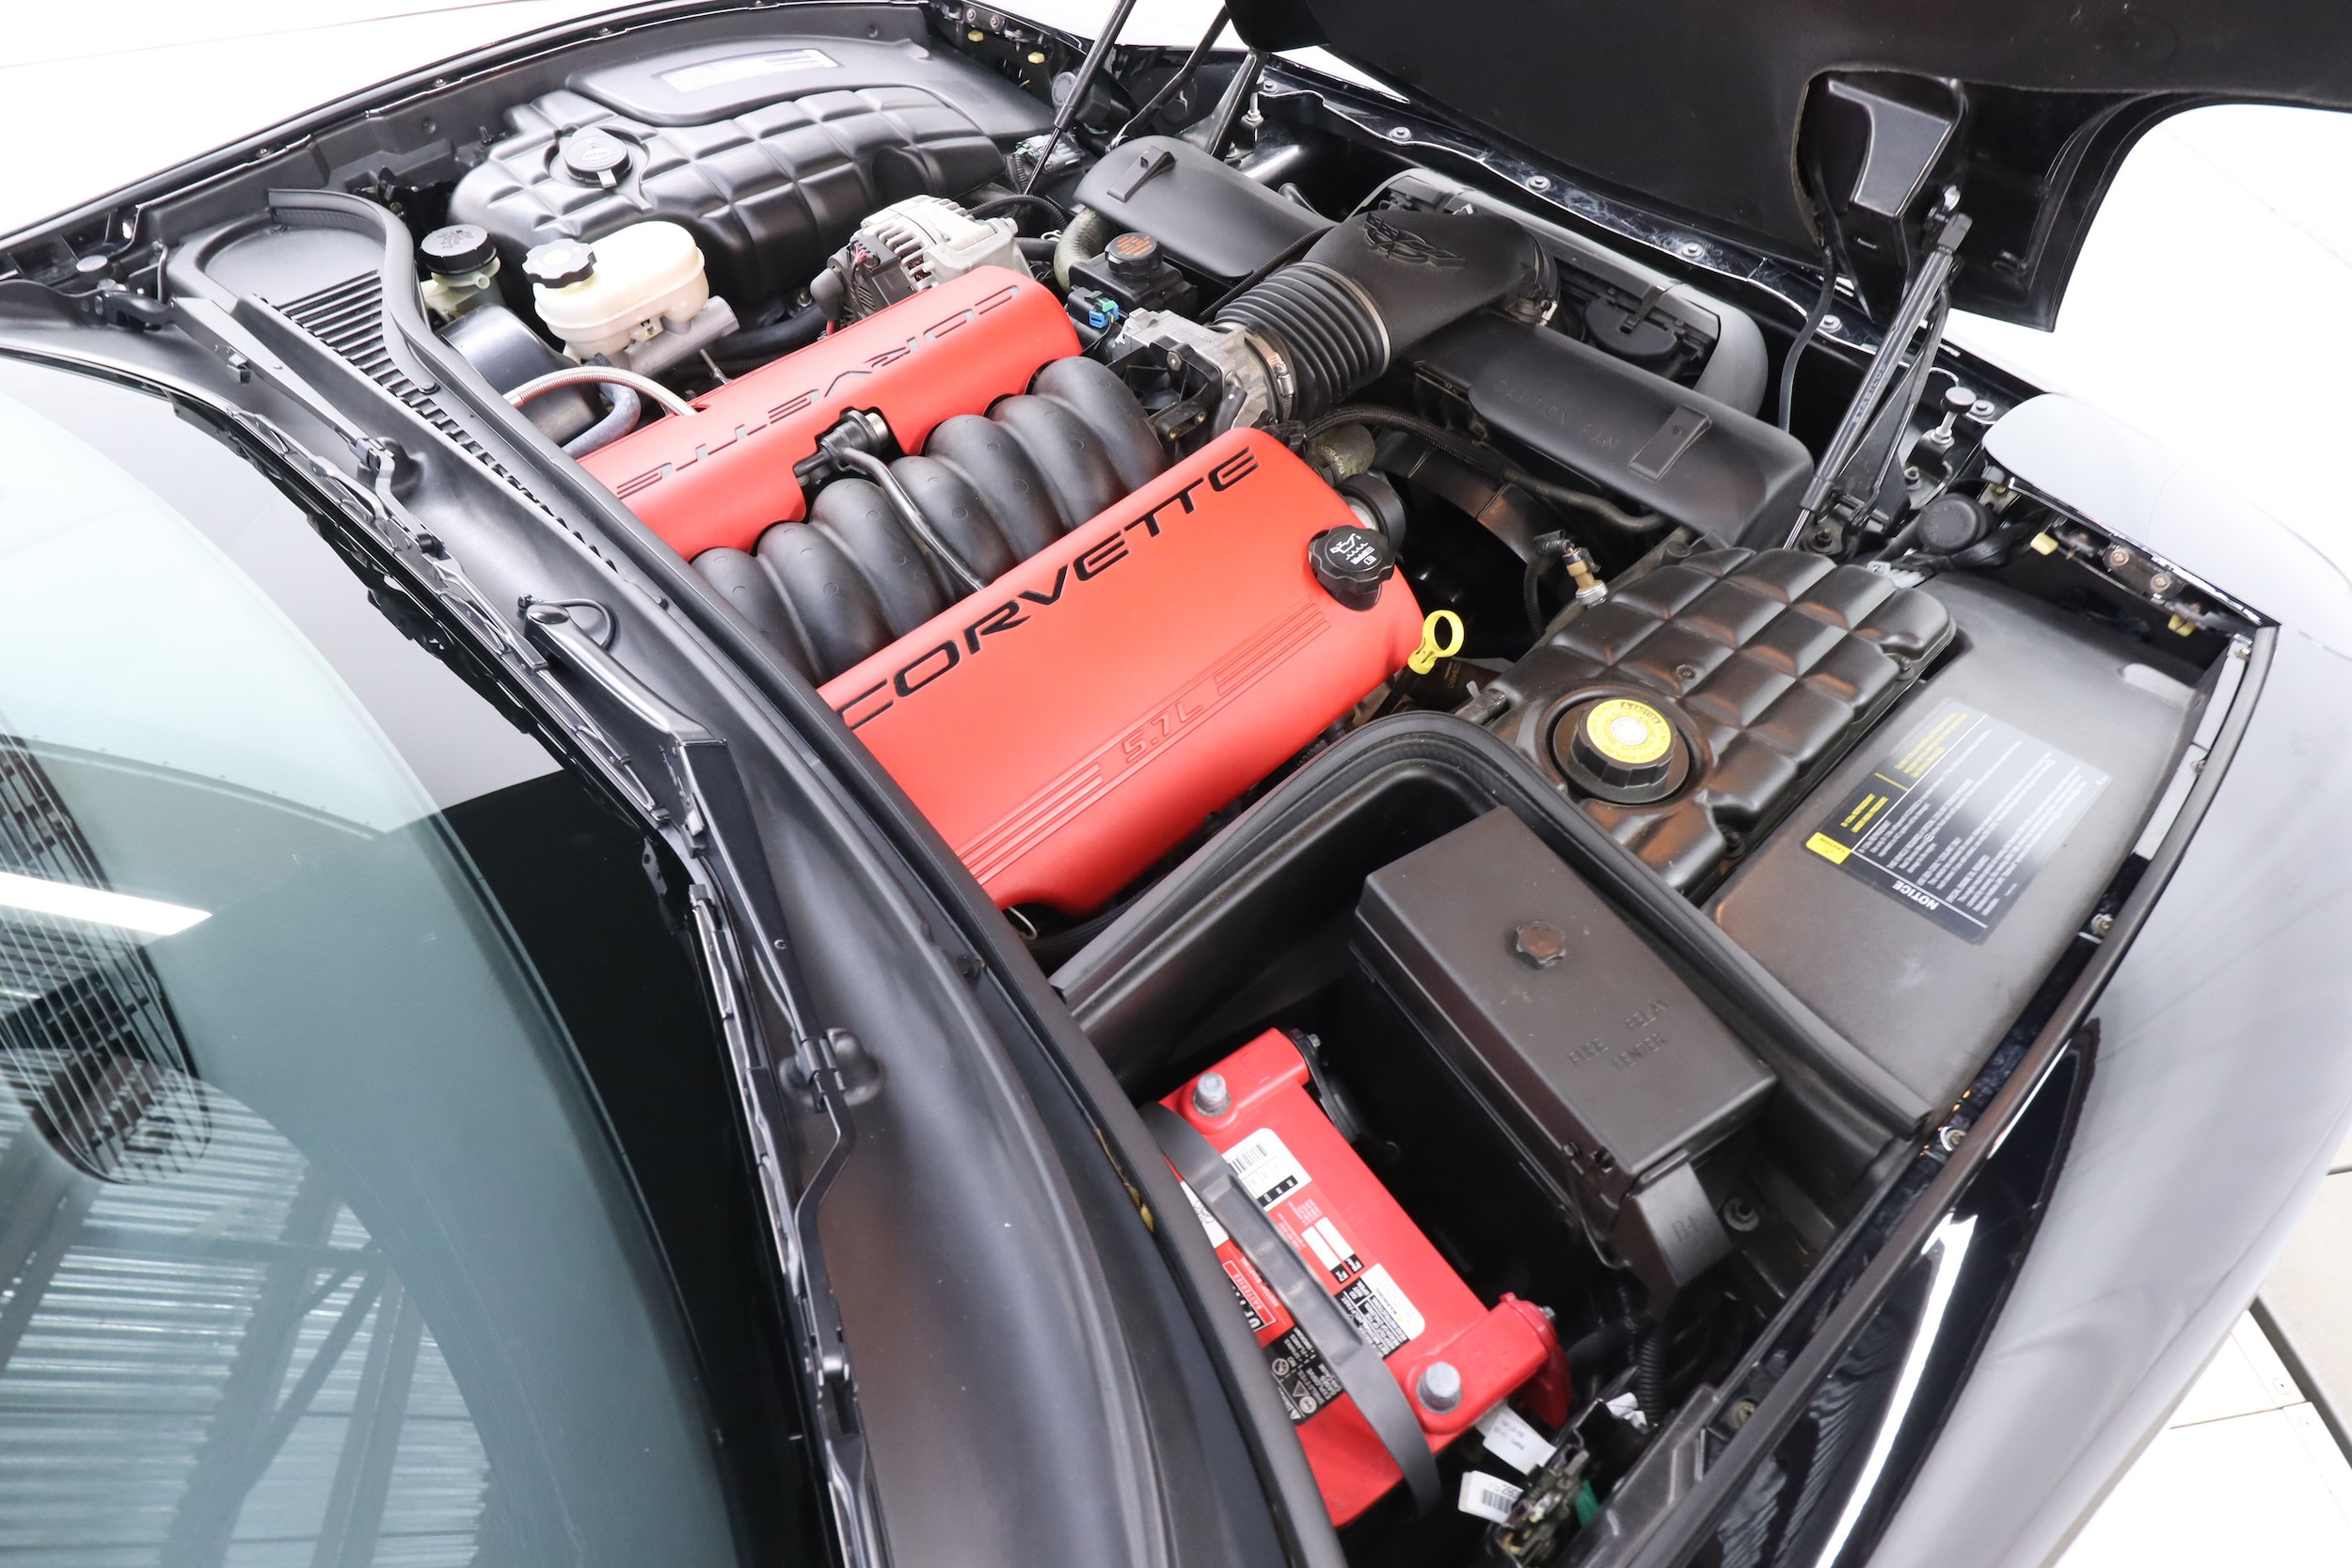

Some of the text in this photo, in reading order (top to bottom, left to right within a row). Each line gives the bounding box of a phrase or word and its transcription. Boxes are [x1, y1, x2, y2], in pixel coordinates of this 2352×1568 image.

[836, 447, 1259, 730] CORVETTE
[1631, 705, 1661, 723] CAUTION
[1123, 703, 1204, 764] 5.7L
[1892, 878, 1939, 911] NOTICE
[1671, 1215, 1697, 1242] B+
[1239, 1256, 1263, 1284] STARTING
[1232, 1272, 1263, 1310] BATTERIES
